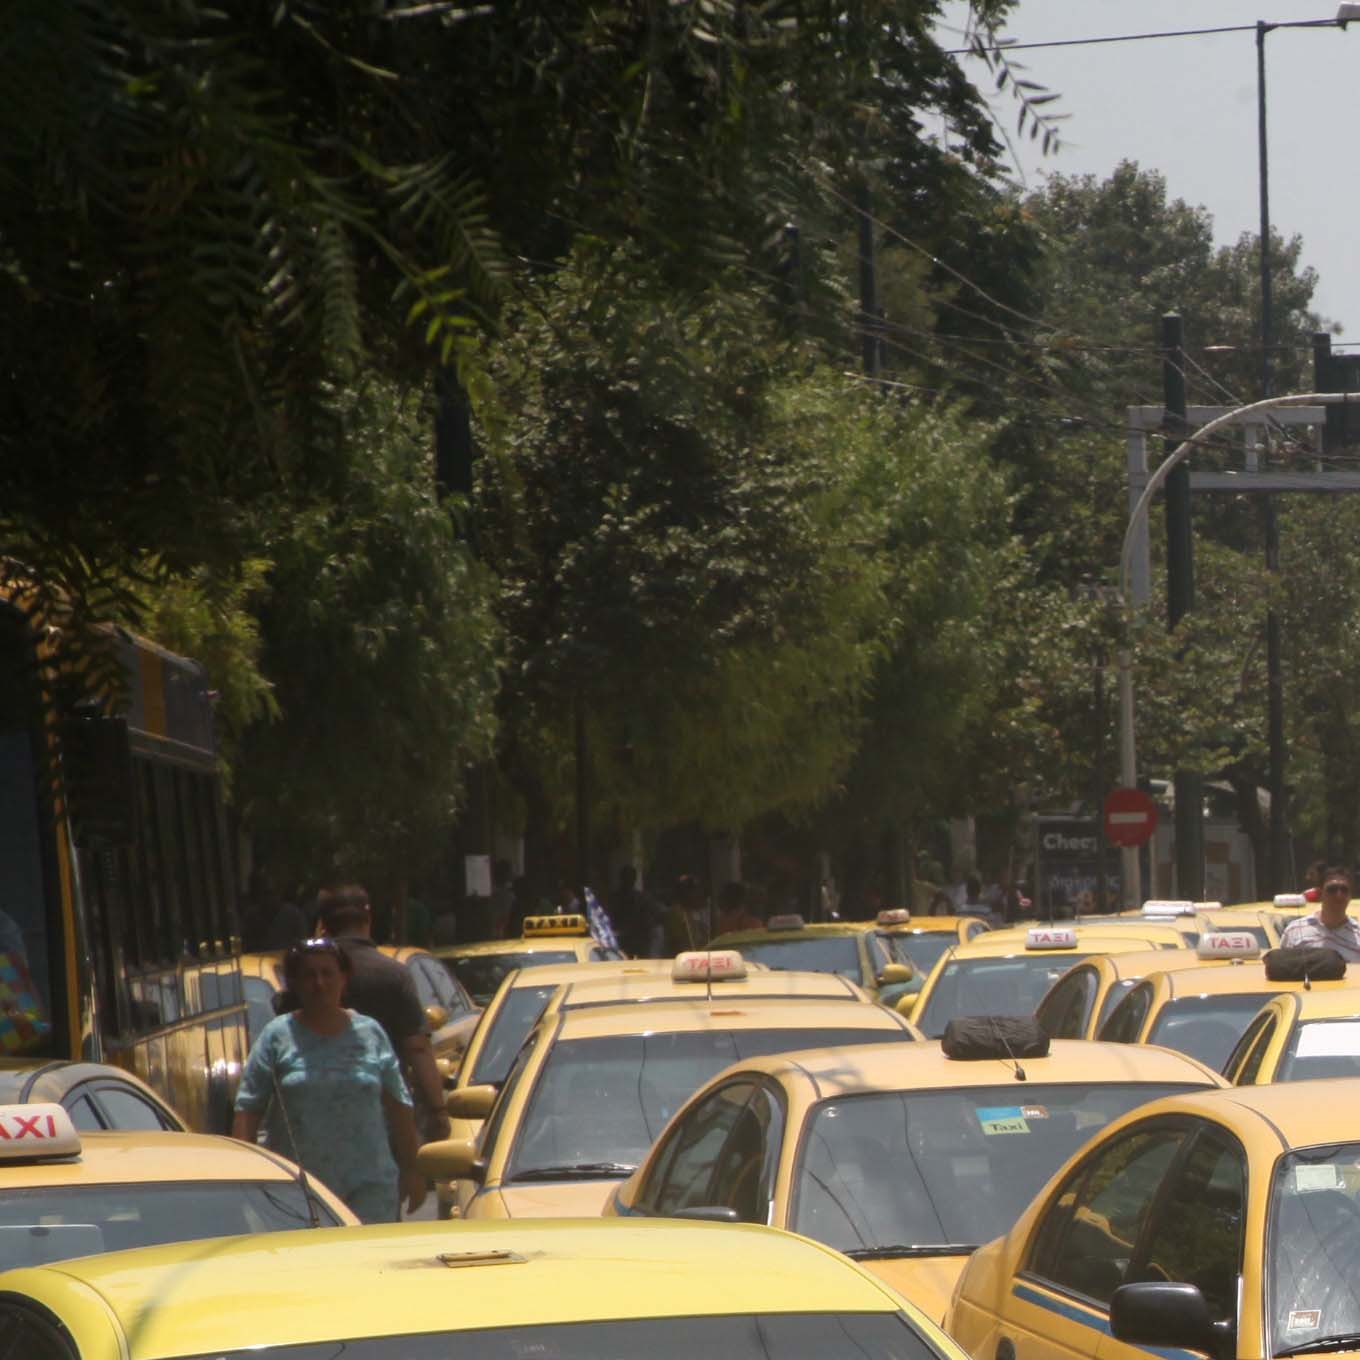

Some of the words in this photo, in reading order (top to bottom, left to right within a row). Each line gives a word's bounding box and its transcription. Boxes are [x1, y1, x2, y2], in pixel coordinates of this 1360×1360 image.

[1032, 934, 1069, 943] ΤΑΞΙ
[1210, 937, 1251, 948] ΤΑΞΙ
[688, 958, 732, 969] ΤΑΞΙ
[991, 1122, 1023, 1131] Taxi
